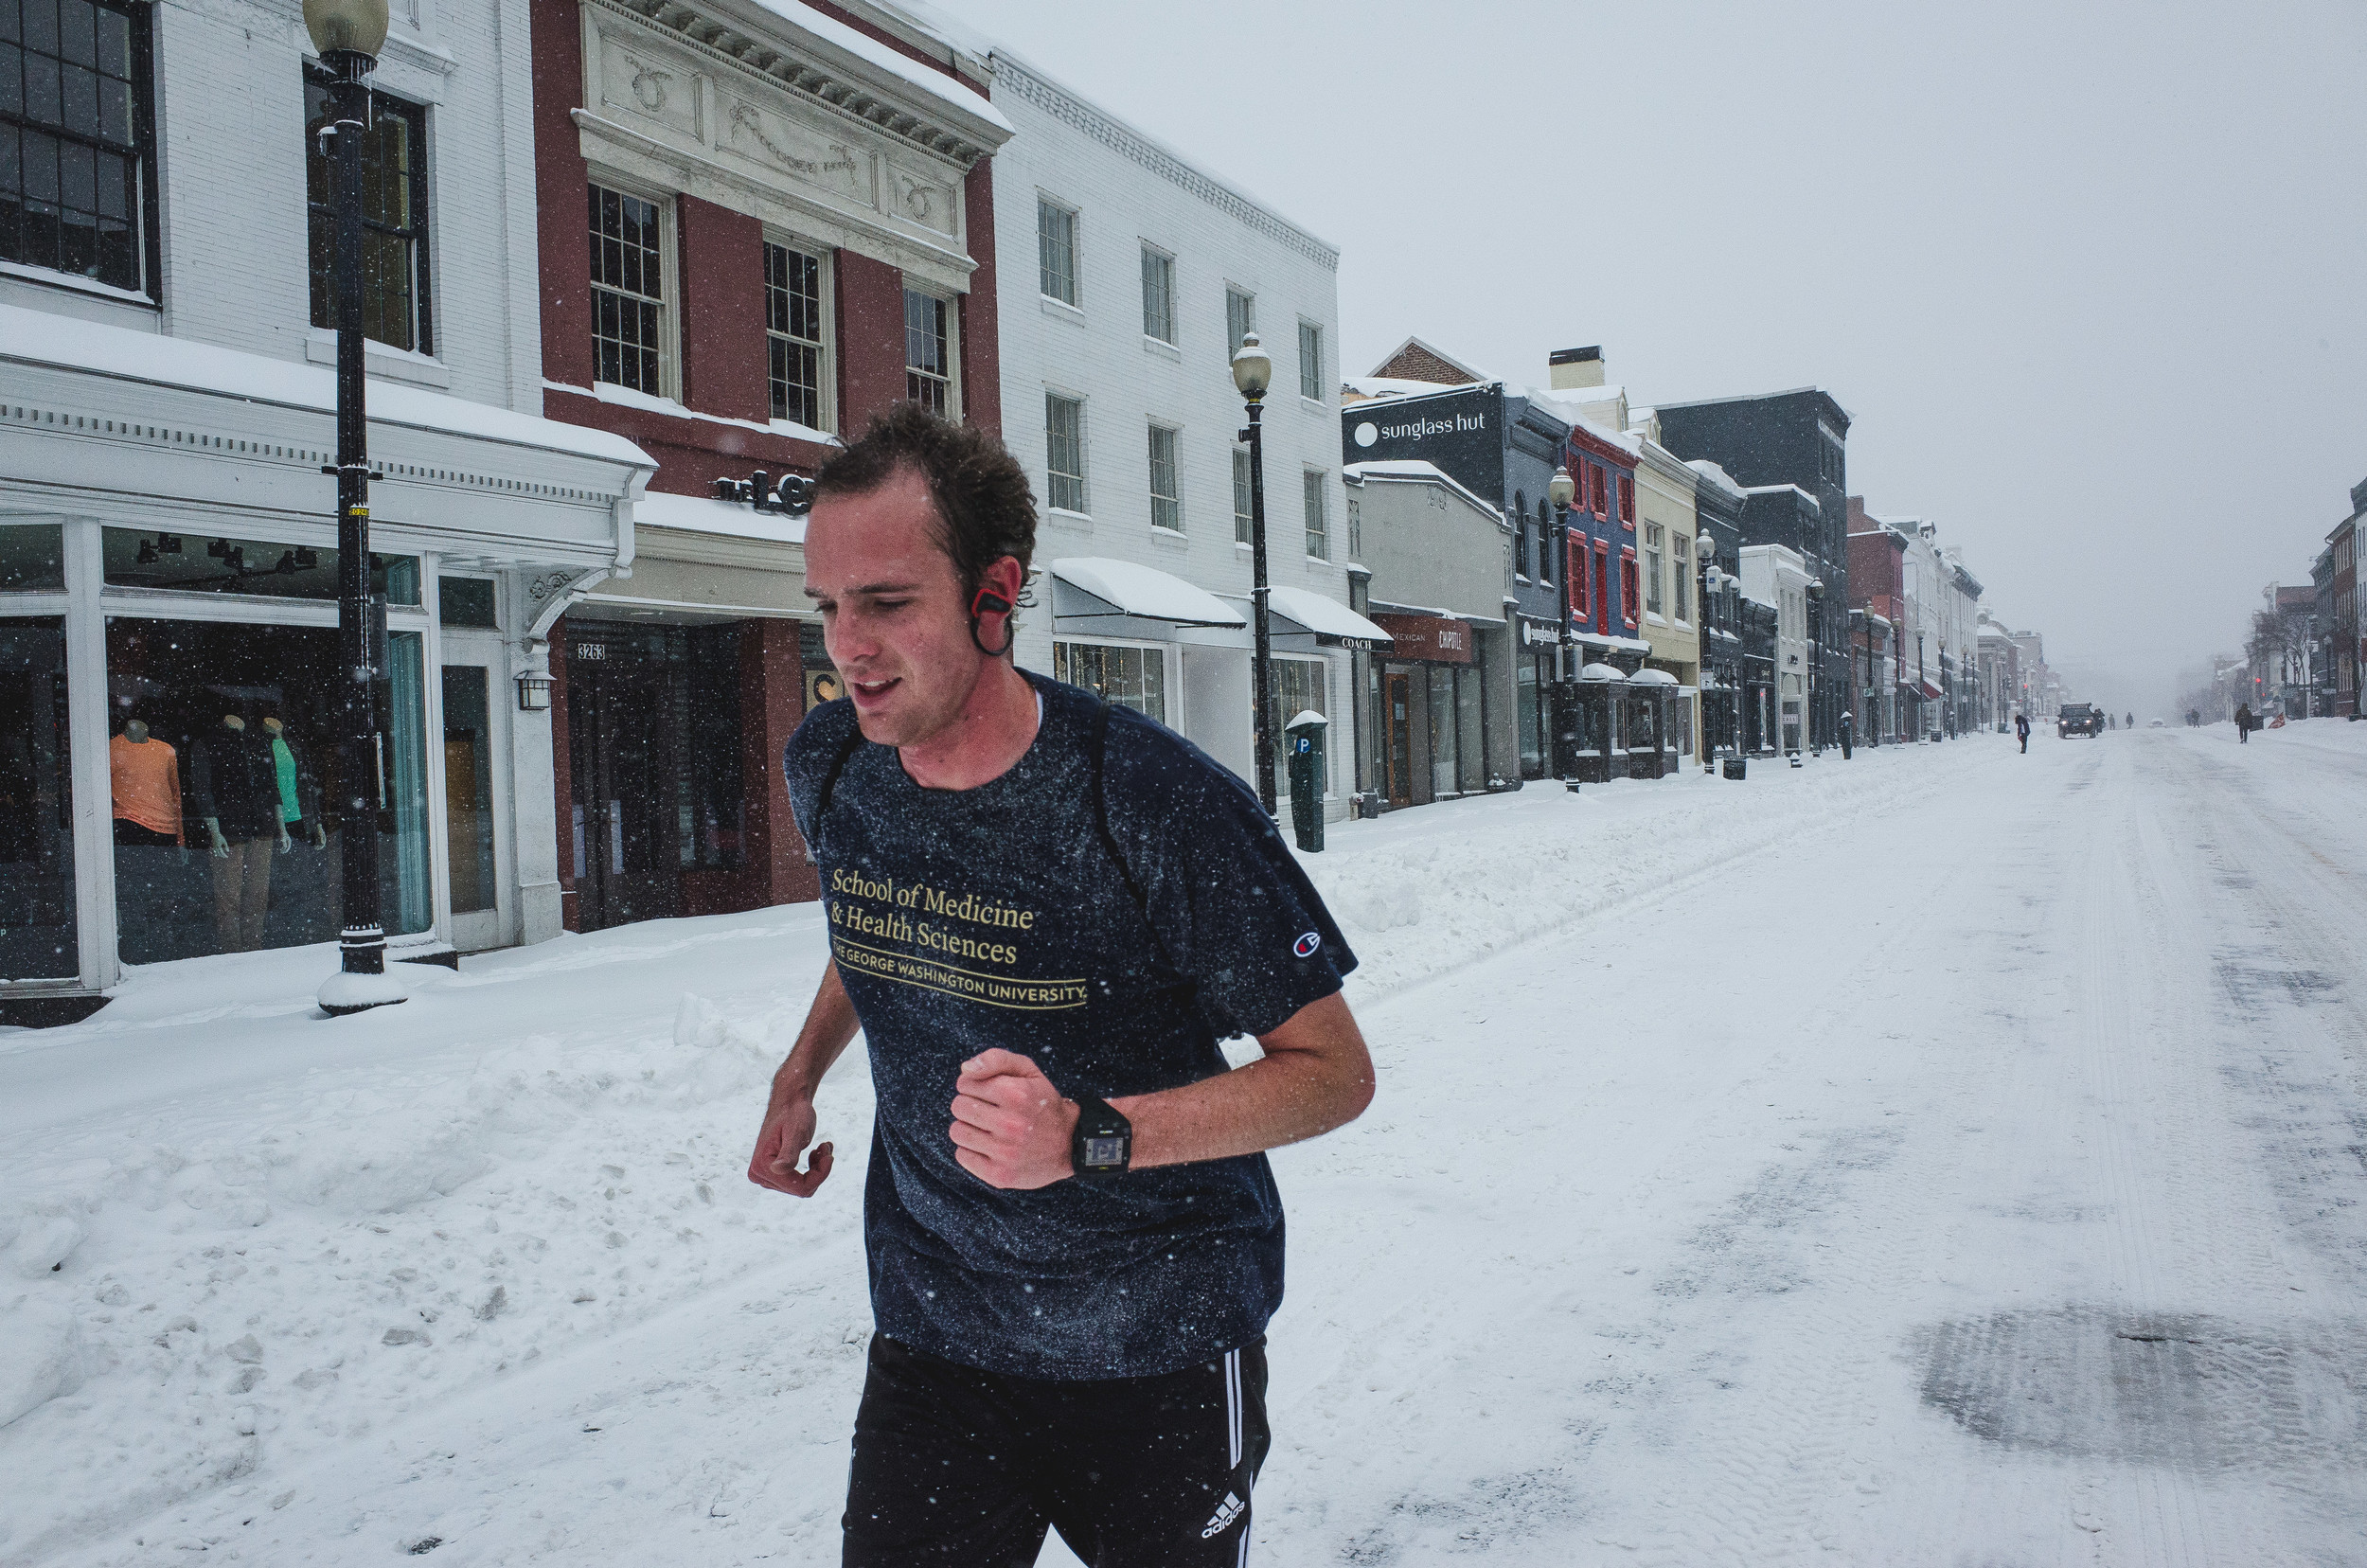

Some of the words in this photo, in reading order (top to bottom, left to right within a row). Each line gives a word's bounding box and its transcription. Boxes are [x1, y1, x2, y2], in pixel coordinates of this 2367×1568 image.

[1381, 418, 1453, 441] sunglass
[1456, 413, 1486, 432] hut
[754, 470, 815, 516] Le
[578, 644, 604, 659] 3263
[1342, 637, 1372, 650] COACH
[1300, 738, 1309, 753] P
[831, 868, 893, 903] School
[897, 883, 924, 909] of
[923, 887, 1034, 930] Medicine
[830, 900, 844, 925] &
[845, 905, 913, 943] Health
[917, 922, 1017, 964] Sciences
[846, 949, 895, 972] GEORGE
[897, 960, 986, 993] WASHINGTON
[1201, 1501, 1245, 1539] adidas
